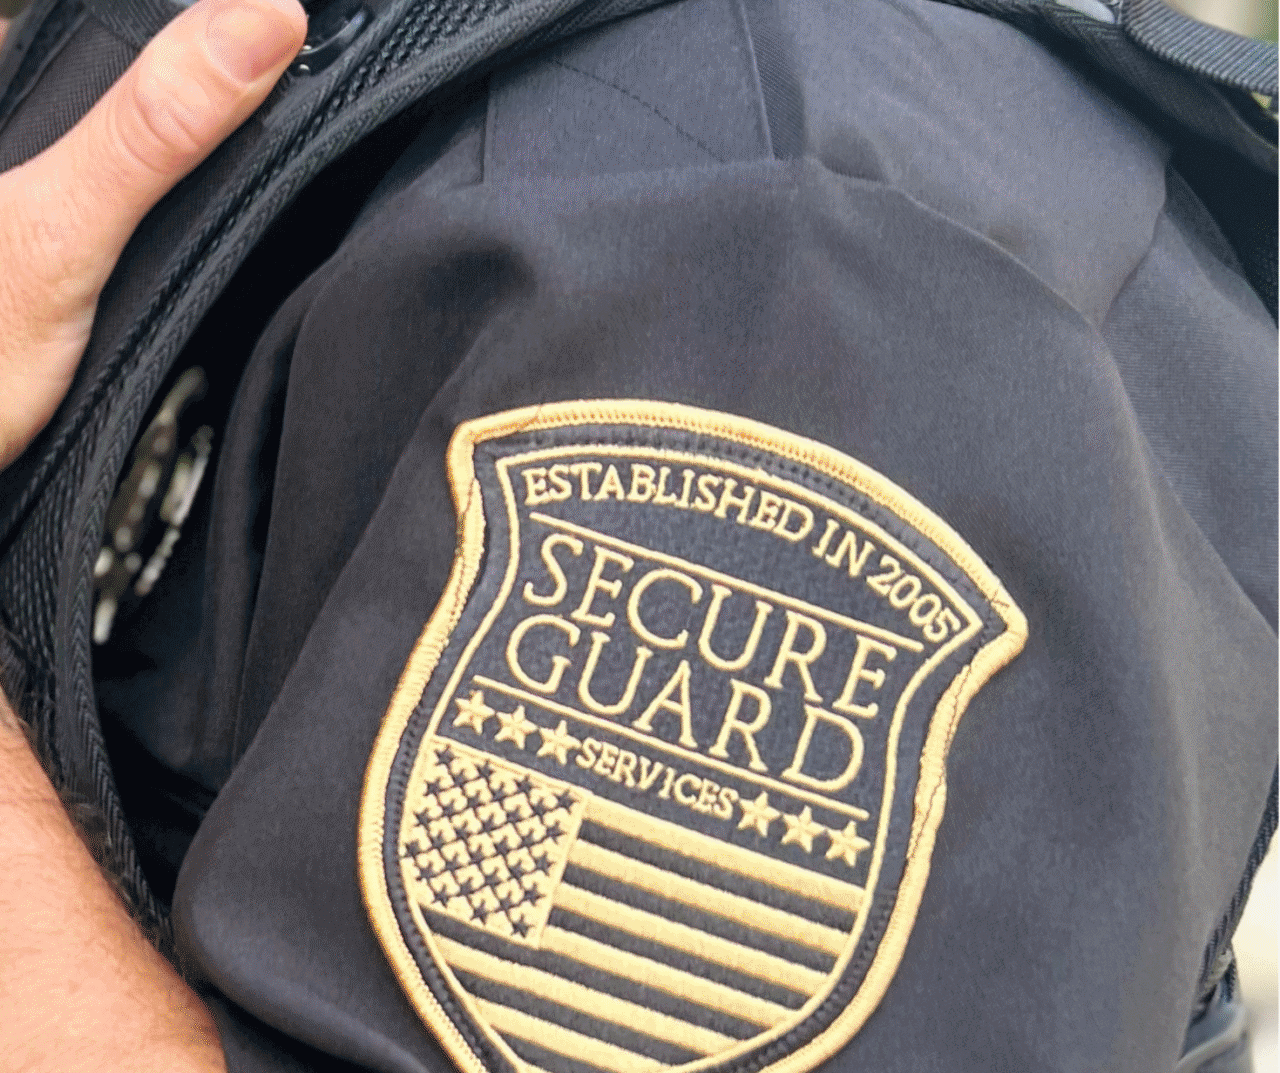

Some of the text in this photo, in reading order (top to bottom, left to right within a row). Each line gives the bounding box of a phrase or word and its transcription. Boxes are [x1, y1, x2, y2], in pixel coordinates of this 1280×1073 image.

[523, 461, 962, 644] ESTABLISHED IN 2005
[523, 532, 898, 719] SECURE
[505, 615, 865, 792] GUARD
[574, 739, 741, 820] SERVICES
